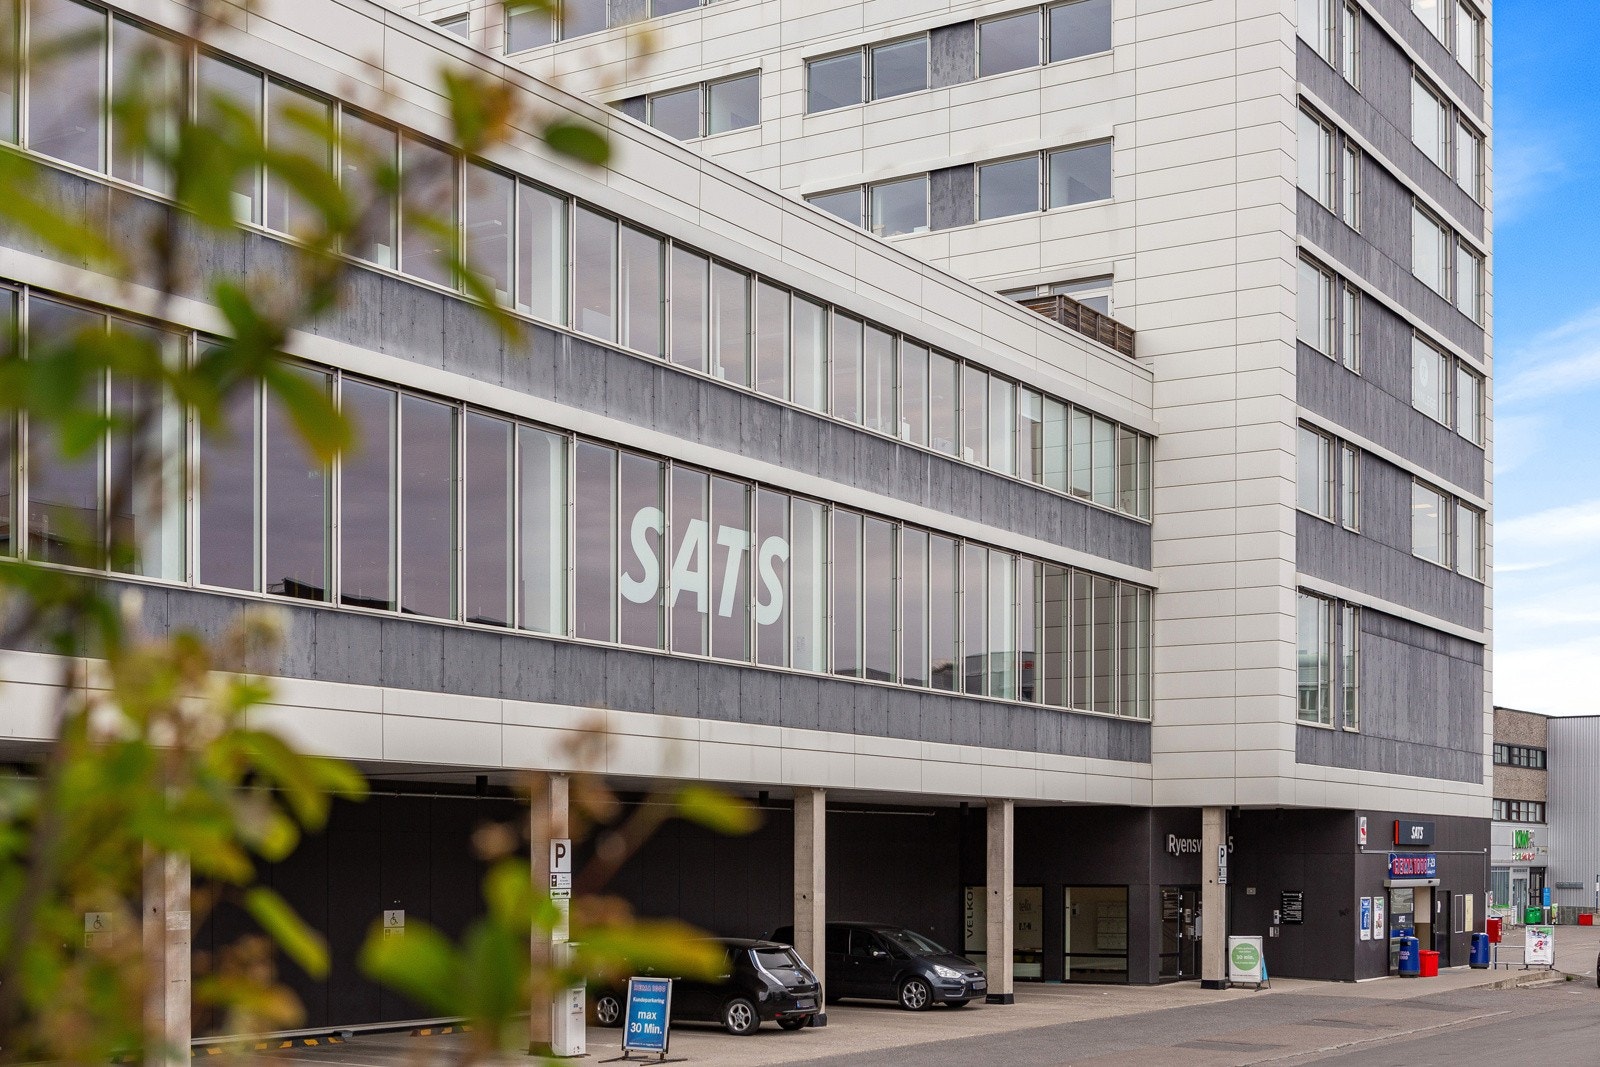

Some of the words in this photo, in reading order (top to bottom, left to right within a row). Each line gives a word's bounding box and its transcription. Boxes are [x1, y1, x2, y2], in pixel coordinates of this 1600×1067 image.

[620, 506, 790, 626] SATS
[1411, 826, 1424, 839] SATS
[555, 843, 566, 868] P
[1220, 847, 1225, 864] P
[1394, 858, 1413, 875] REMA
[1413, 858, 1427, 875] 1000
[637, 1011, 657, 1020] max
[630, 1022, 642, 1033] 30
[643, 1023, 663, 1034] Min.
